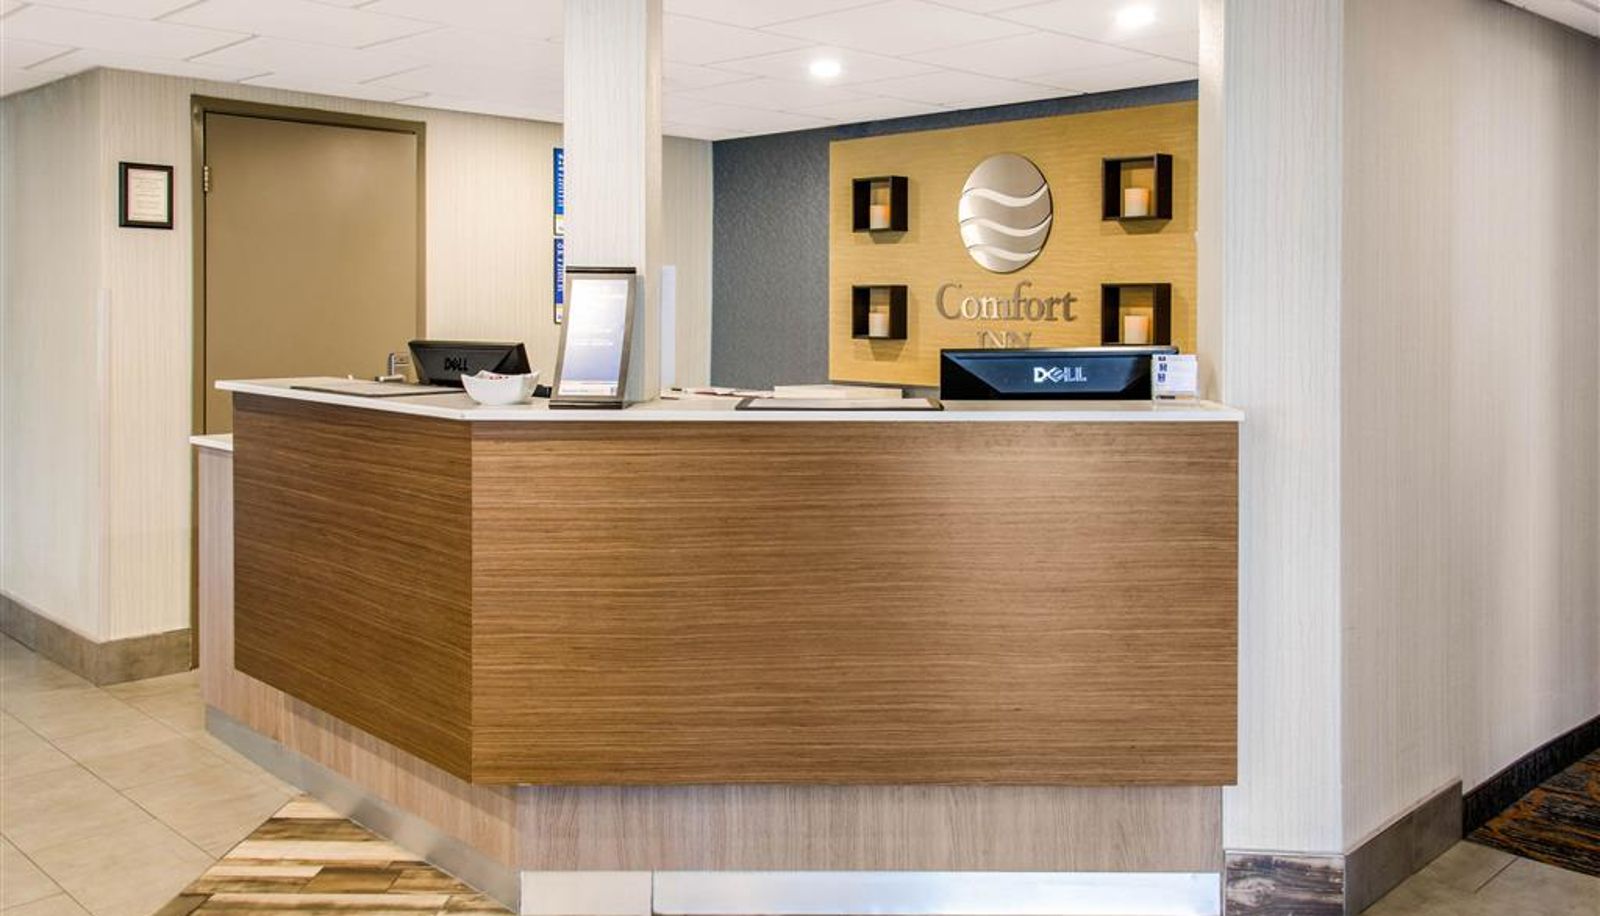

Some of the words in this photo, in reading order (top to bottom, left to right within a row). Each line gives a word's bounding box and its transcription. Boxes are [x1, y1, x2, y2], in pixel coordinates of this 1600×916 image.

[936, 280, 1078, 322] Comfort
[976, 330, 1031, 349] INN
[444, 356, 468, 372] DELL
[1033, 366, 1087, 383] DELL
